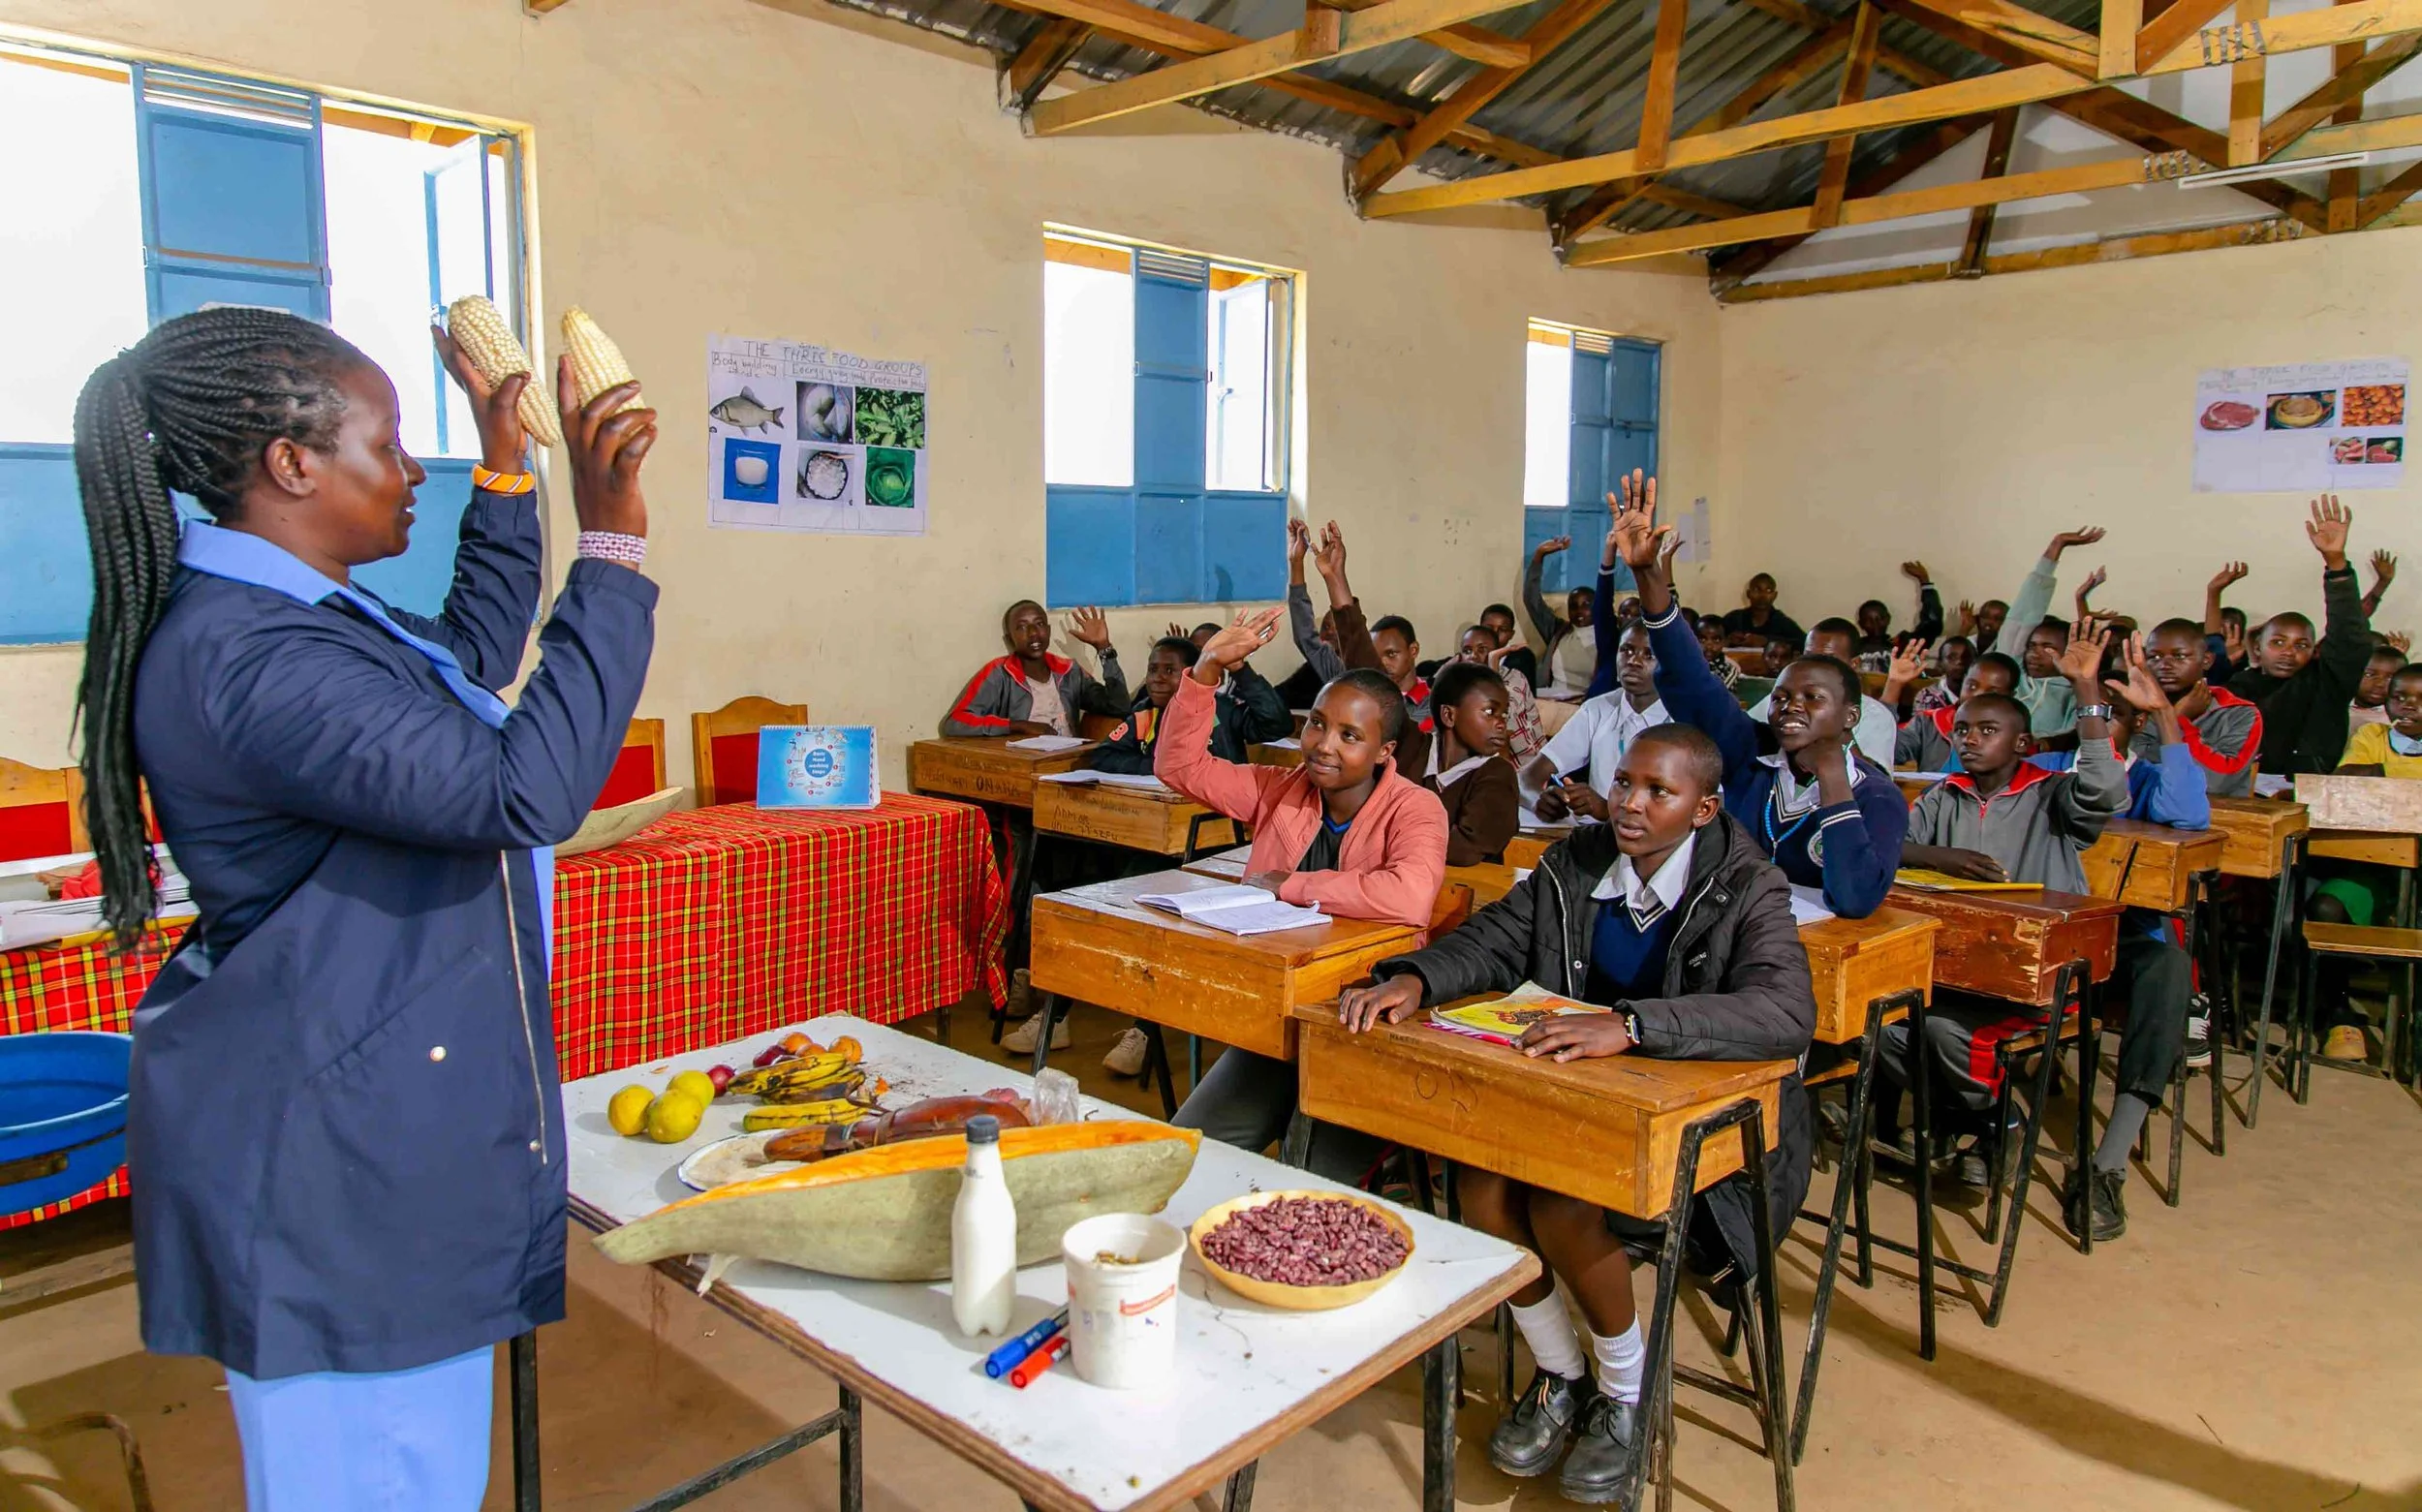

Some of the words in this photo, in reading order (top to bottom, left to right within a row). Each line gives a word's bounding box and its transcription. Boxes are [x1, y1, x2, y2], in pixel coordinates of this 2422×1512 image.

[743, 341, 770, 357] THE
[783, 347, 825, 364] THREE
[831, 352, 869, 369] FOOD
[875, 360, 923, 378] GROUPS
